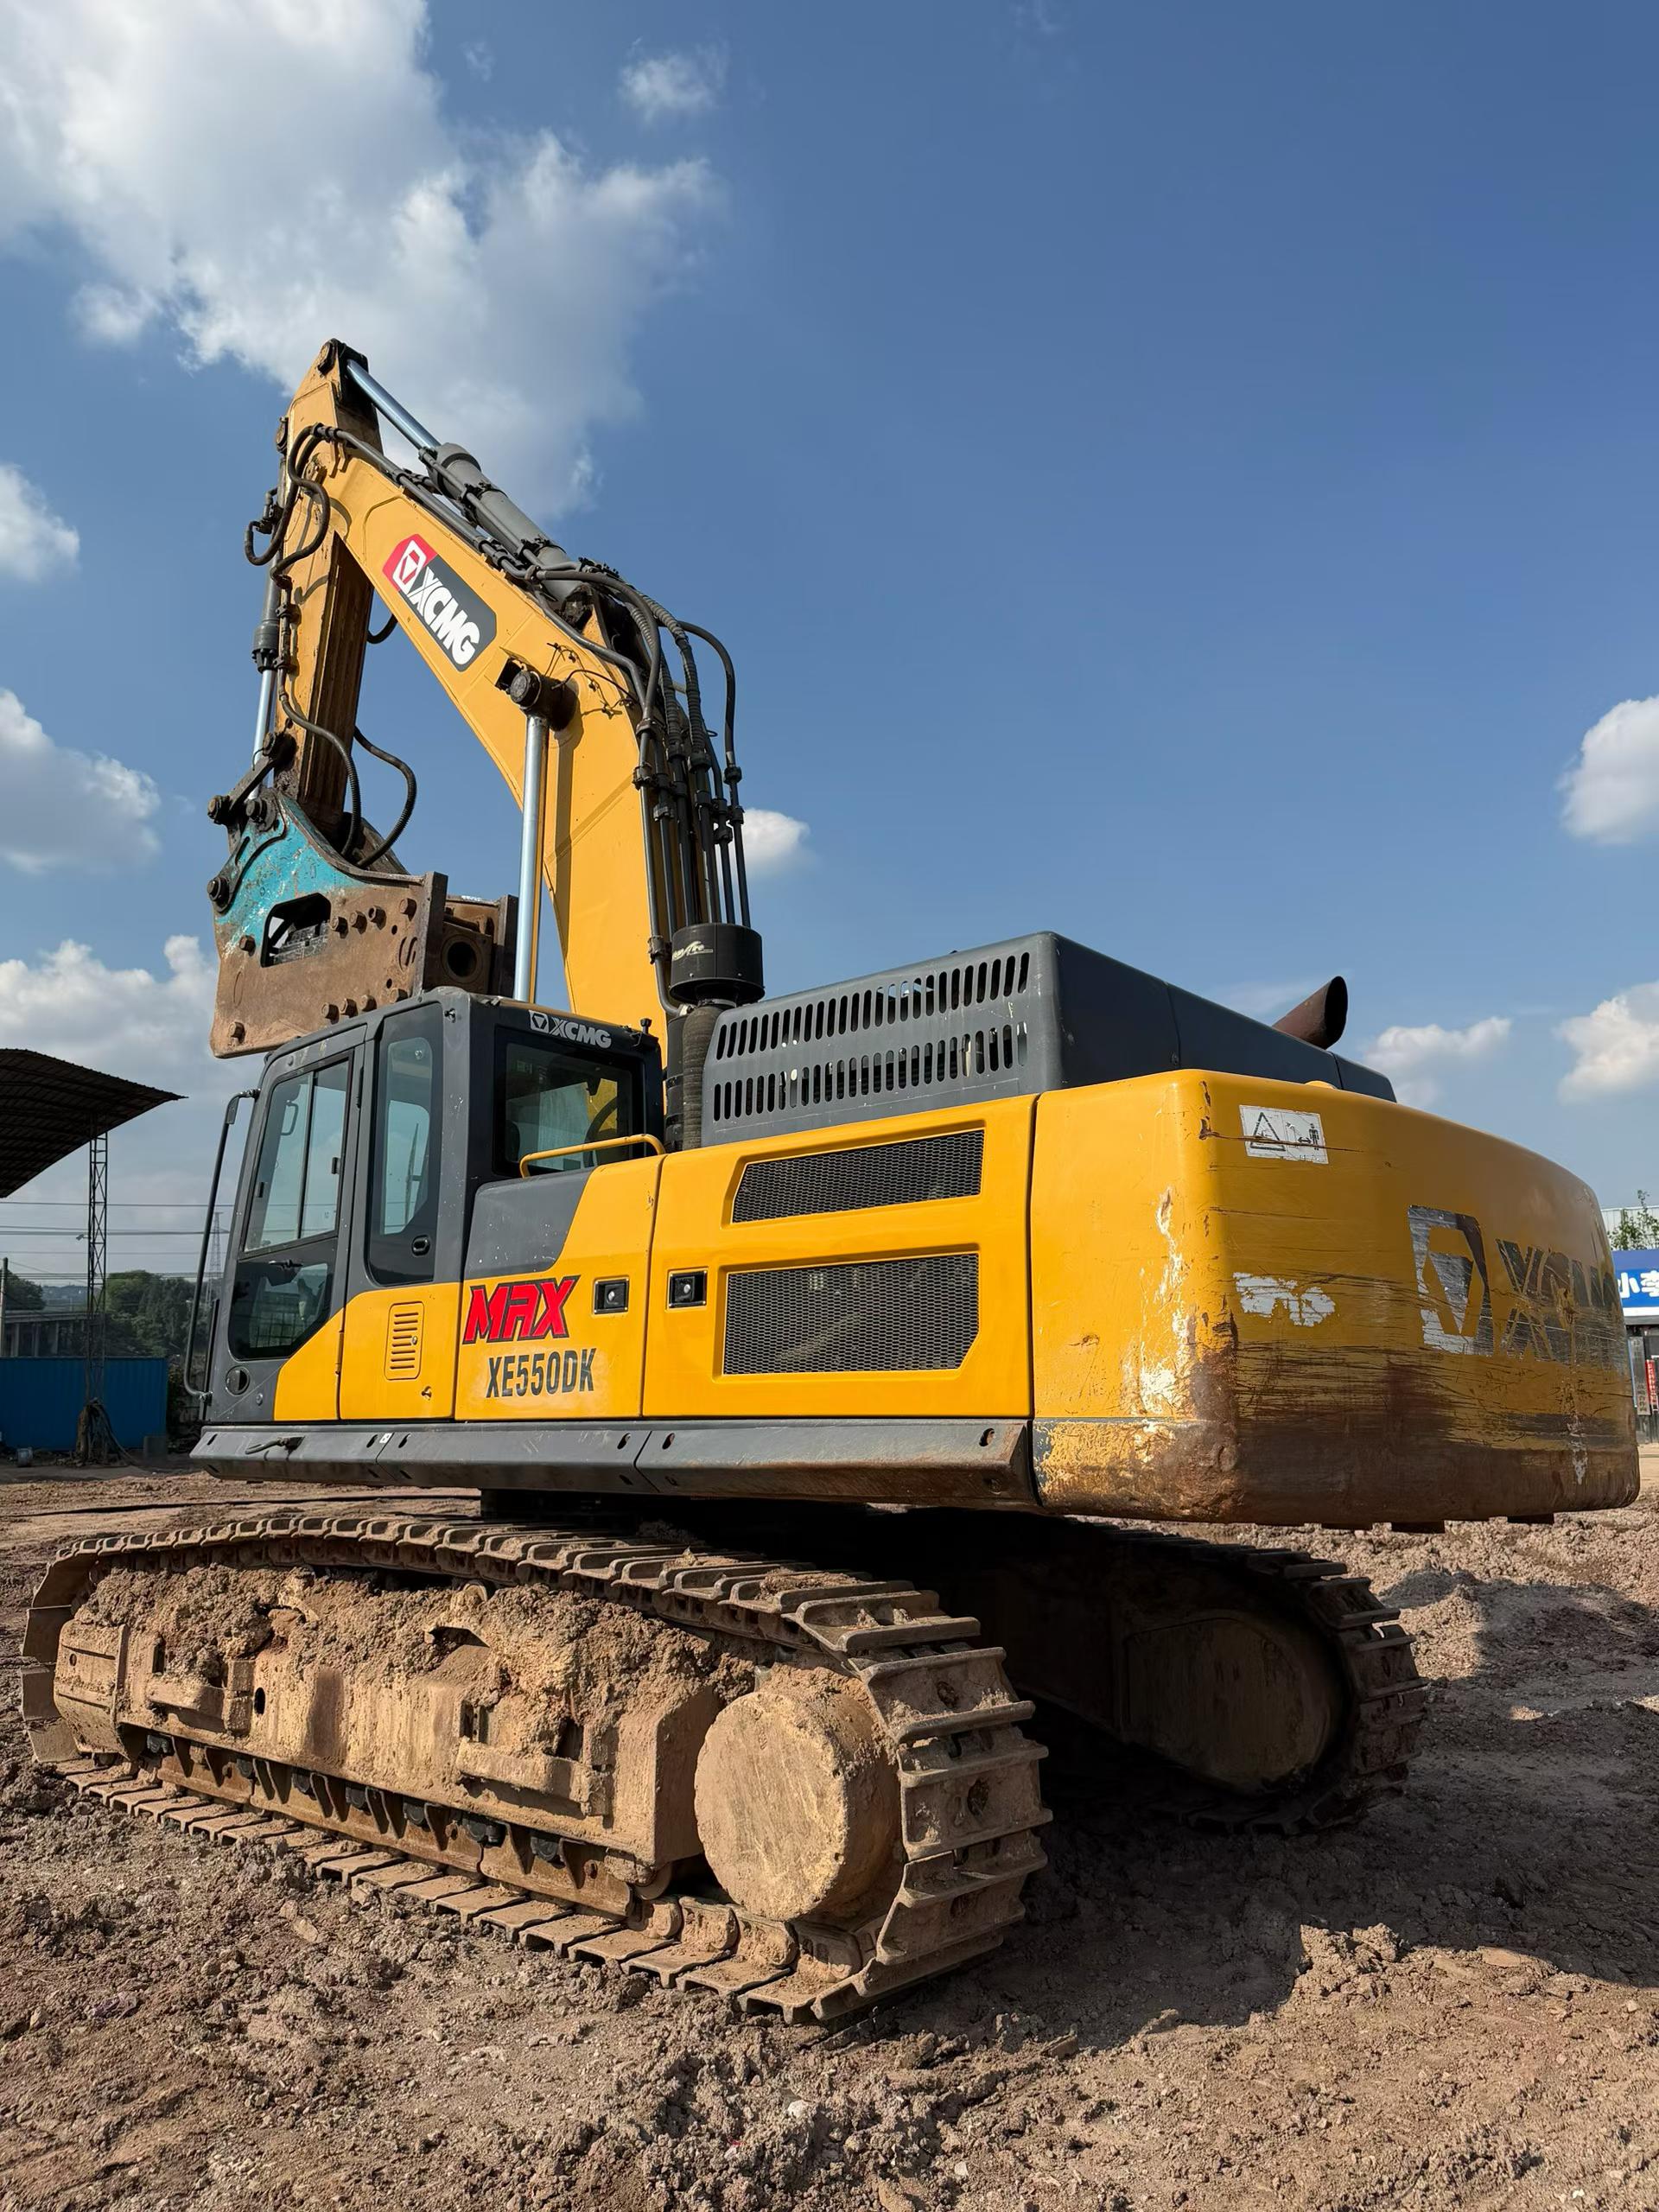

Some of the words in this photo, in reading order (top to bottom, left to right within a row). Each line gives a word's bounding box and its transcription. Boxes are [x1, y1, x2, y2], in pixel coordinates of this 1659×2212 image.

[406, 566, 480, 665] XCMG
[549, 1015, 612, 1049] XCMG
[462, 1274, 582, 1344] MAX
[486, 1348, 596, 1398] XE550DK
